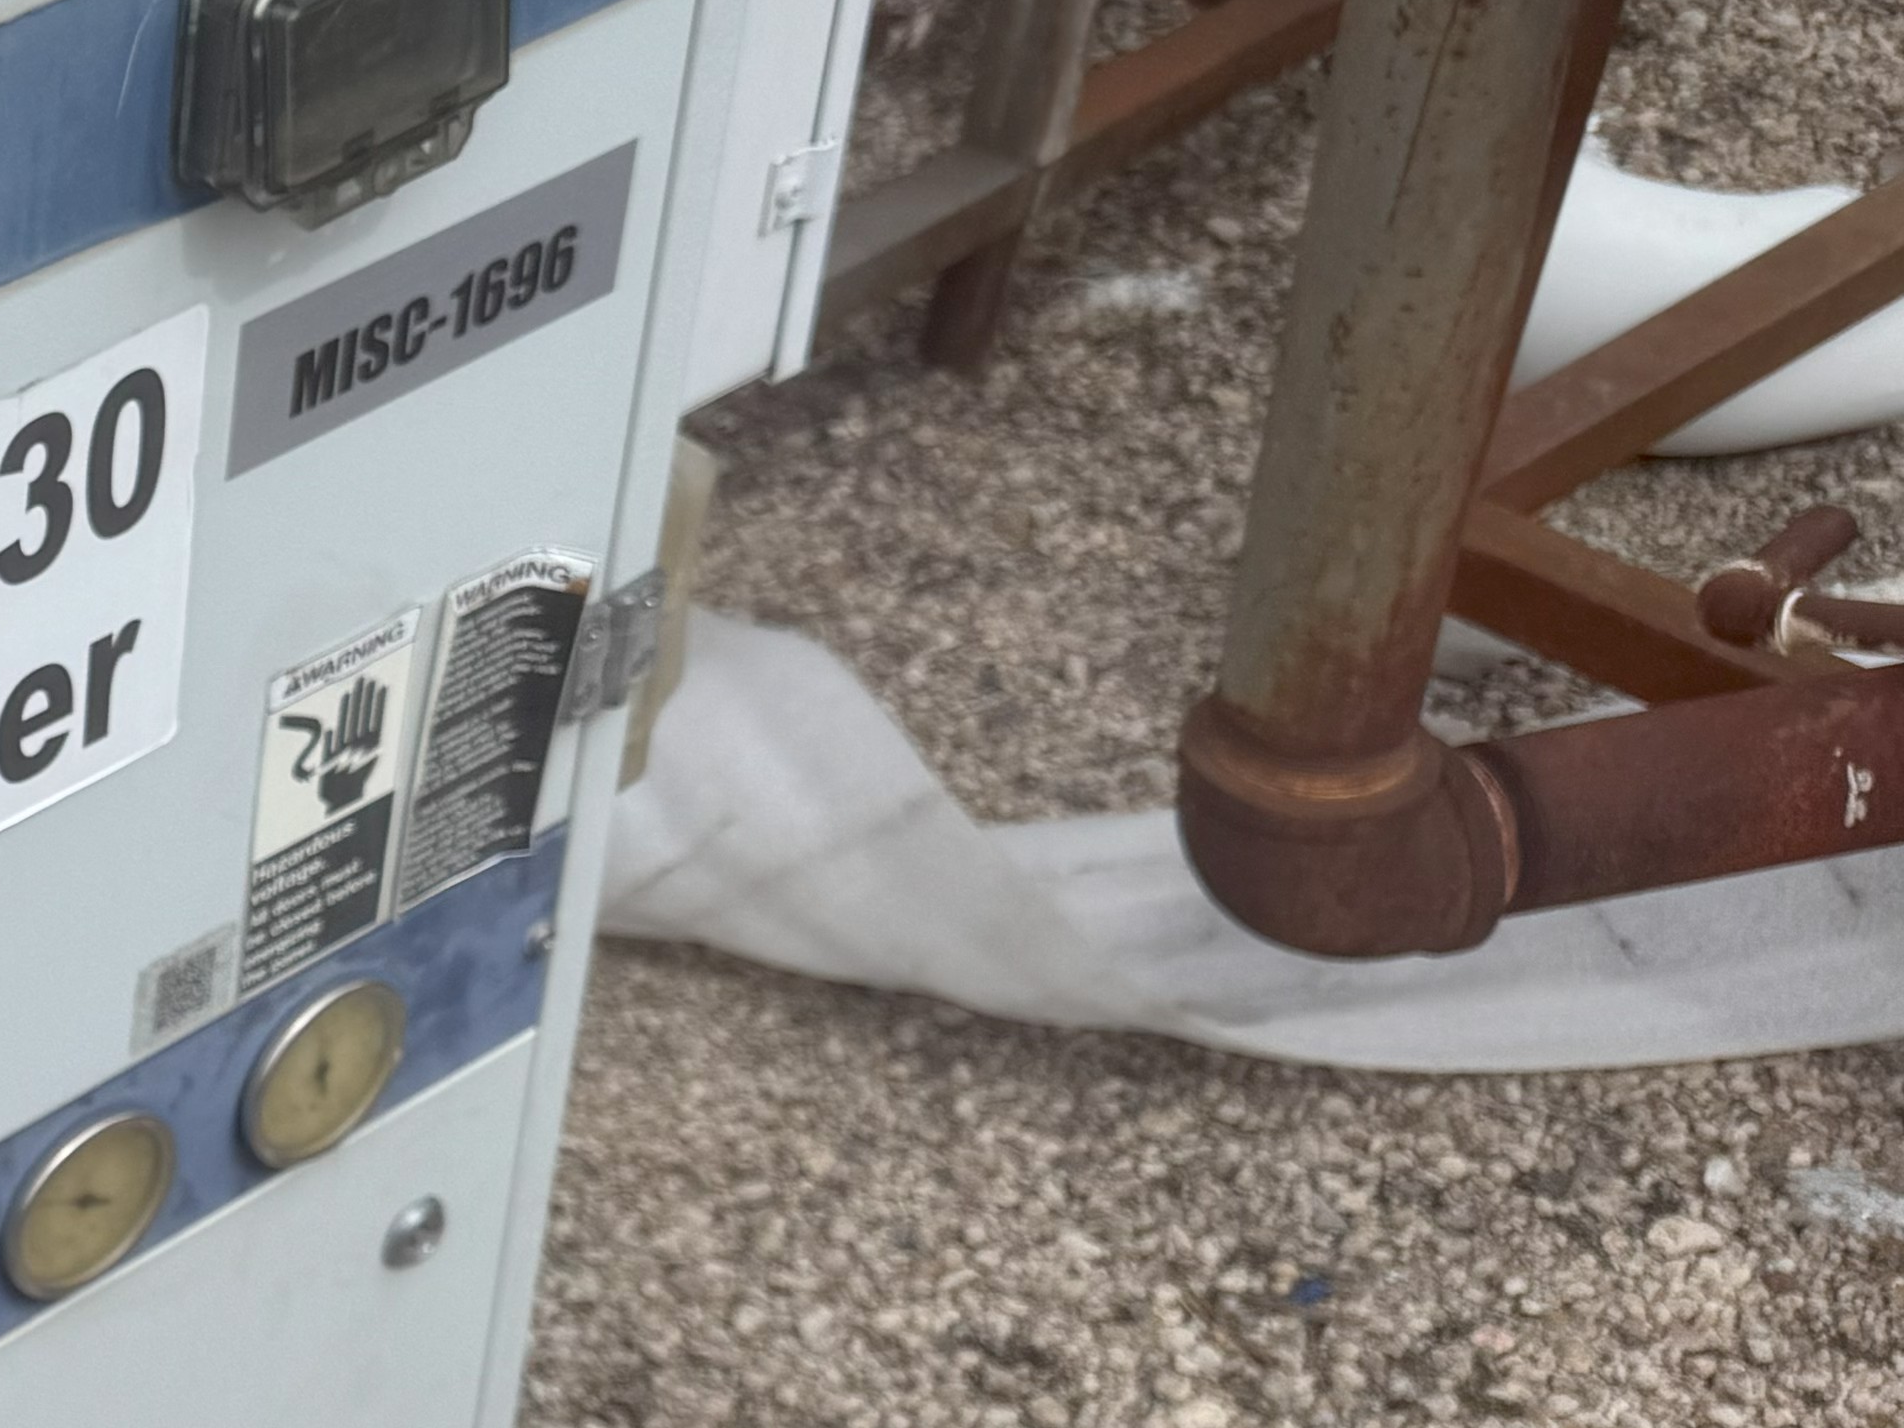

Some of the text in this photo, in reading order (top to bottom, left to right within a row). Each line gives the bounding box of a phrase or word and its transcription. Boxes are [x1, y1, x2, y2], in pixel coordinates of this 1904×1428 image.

[290, 224, 578, 418] MISC-1696
[455, 562, 570, 606] WARNING
[300, 620, 405, 688] WARNING
[253, 821, 356, 884] Hazardous
